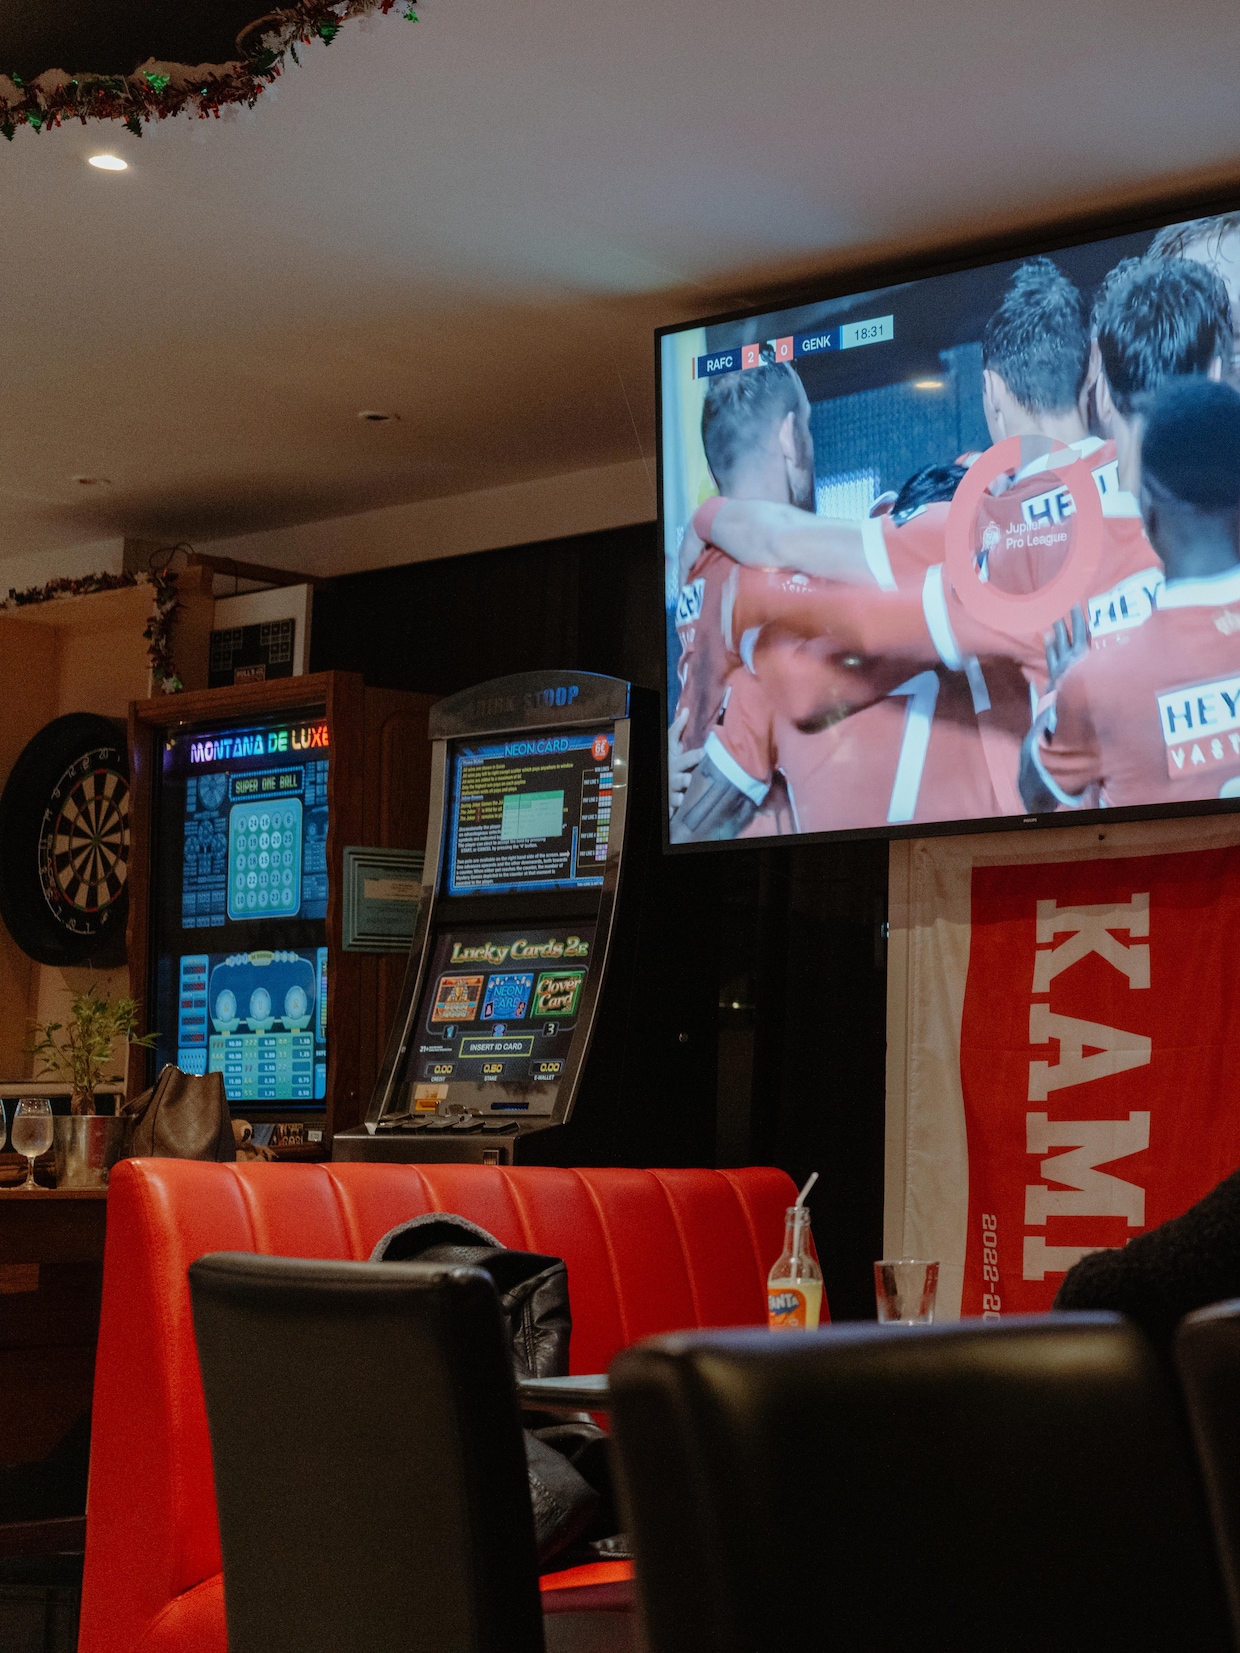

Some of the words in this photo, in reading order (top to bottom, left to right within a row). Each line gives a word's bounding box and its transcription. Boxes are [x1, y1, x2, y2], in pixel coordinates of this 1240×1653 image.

[706, 356, 733, 372] RAFC
[747, 352, 755, 363] 2
[780, 344, 788, 356] 0
[802, 335, 831, 351] GENK
[854, 325, 884, 341] 18:31
[1006, 538, 1024, 549] Pro
[1027, 532, 1067, 547] League
[190, 734, 264, 763] MONTANA
[268, 731, 288, 753] DE
[292, 725, 329, 750] LUXE
[504, 742, 535, 757] NEON
[537, 739, 569, 754] CARD
[235, 780, 258, 794] SUPER
[262, 777, 276, 790] ONE
[280, 774, 298, 789] BALL
[452, 943, 509, 964] Lucky
[511, 939, 563, 959] Cards
[494, 985, 523, 997] NEON
[538, 979, 581, 994] Clover
[492, 998, 521, 1008] CARD
[539, 993, 573, 1009] Card
[547, 1024, 554, 1036] 3
[470, 1043, 495, 1051] INSERT
[503, 1042, 522, 1050] CARD
[434, 1065, 452, 1074] 0.00
[483, 1064, 502, 1073] 0.50
[540, 1063, 559, 1072] 0.00
